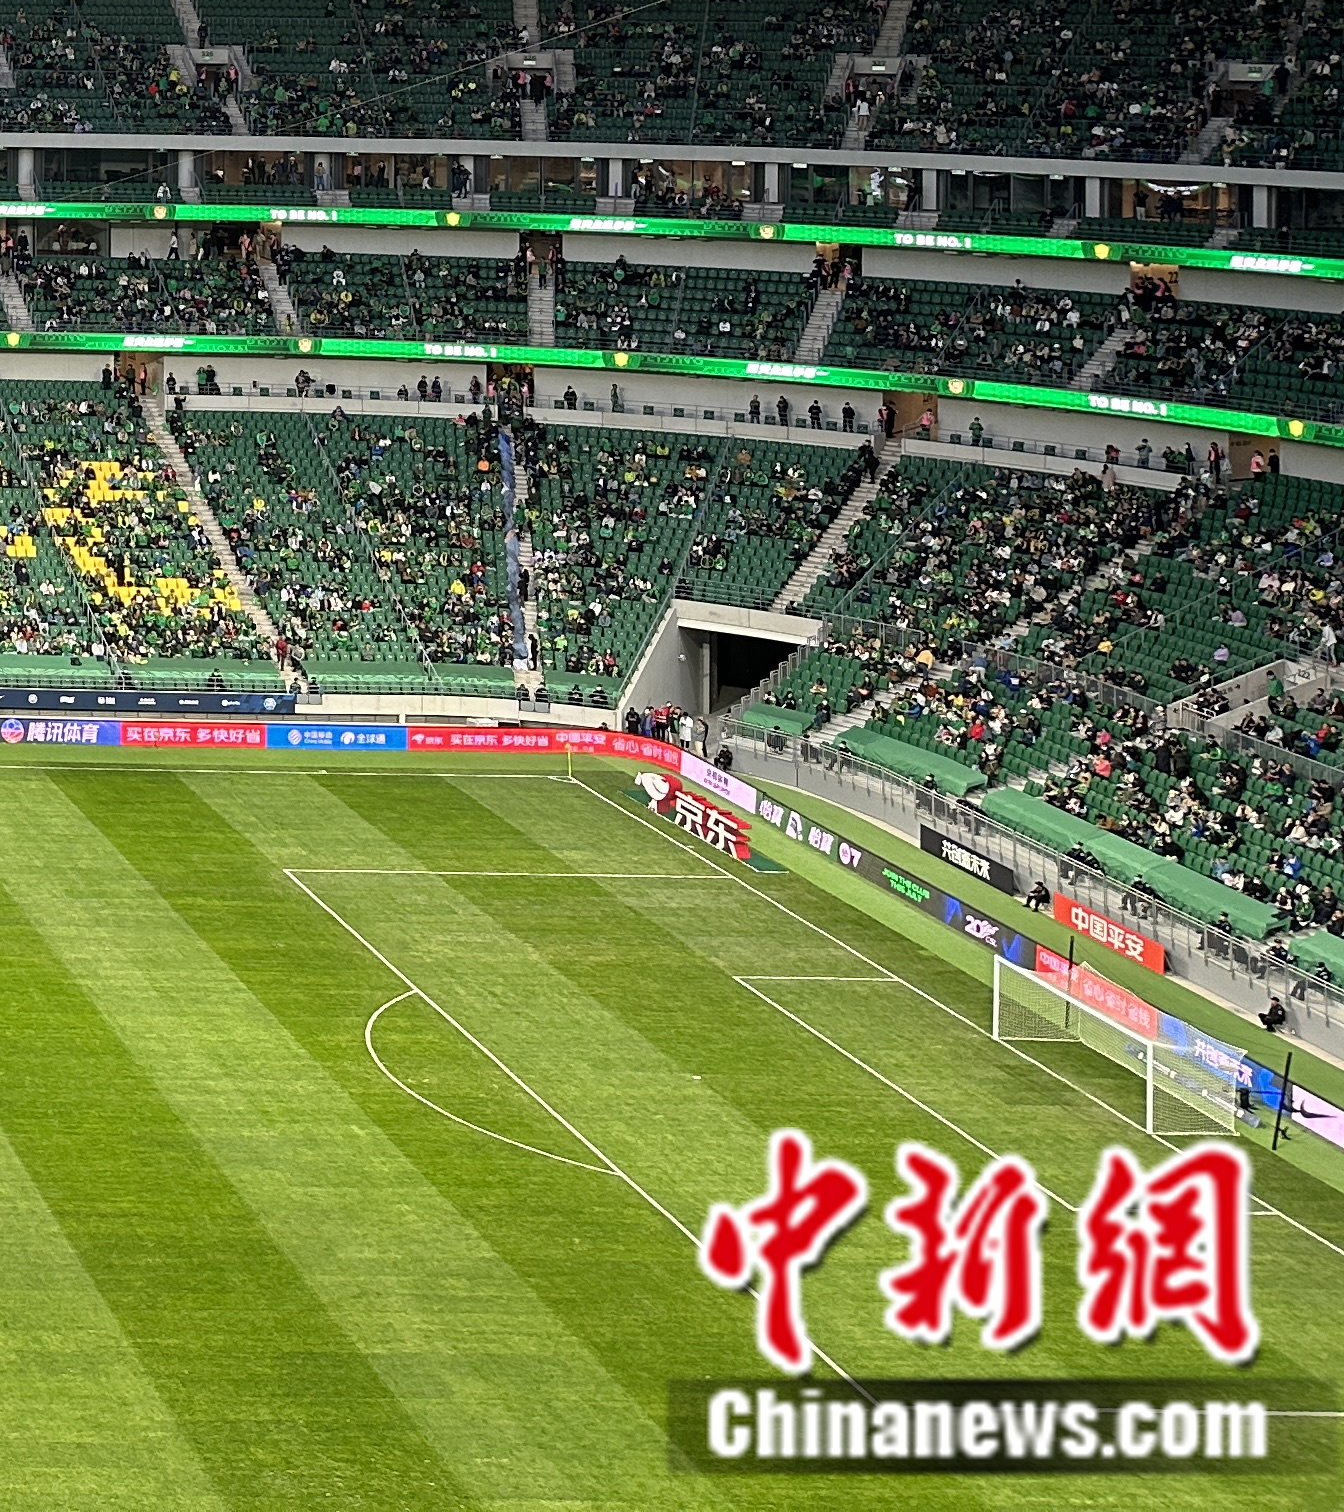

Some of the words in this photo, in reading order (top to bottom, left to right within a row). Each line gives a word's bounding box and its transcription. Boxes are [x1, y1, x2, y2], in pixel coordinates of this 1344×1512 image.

[270, 209, 287, 220] TO
[307, 210, 329, 220] NO.
[332, 210, 337, 221] 1
[894, 233, 913, 244] TO
[937, 236, 962, 248] NO.
[964, 237, 971, 248] 1
[424, 344, 442, 355] TO
[464, 346, 488, 357] NO.
[490, 347, 497, 358] 1
[1088, 396, 1109, 407] TO
[1132, 400, 1159, 414] NO.
[1160, 403, 1167, 416] 1
[27, 721, 99, 743] 腾讯体育
[126, 725, 191, 743] 买在京东
[196, 726, 261, 744] 多快好省
[450, 733, 498, 747] 买在京东
[501, 734, 549, 748] 多快好省
[674, 790, 738, 860] 京东
[1070, 905, 1146, 963] 中国平安
